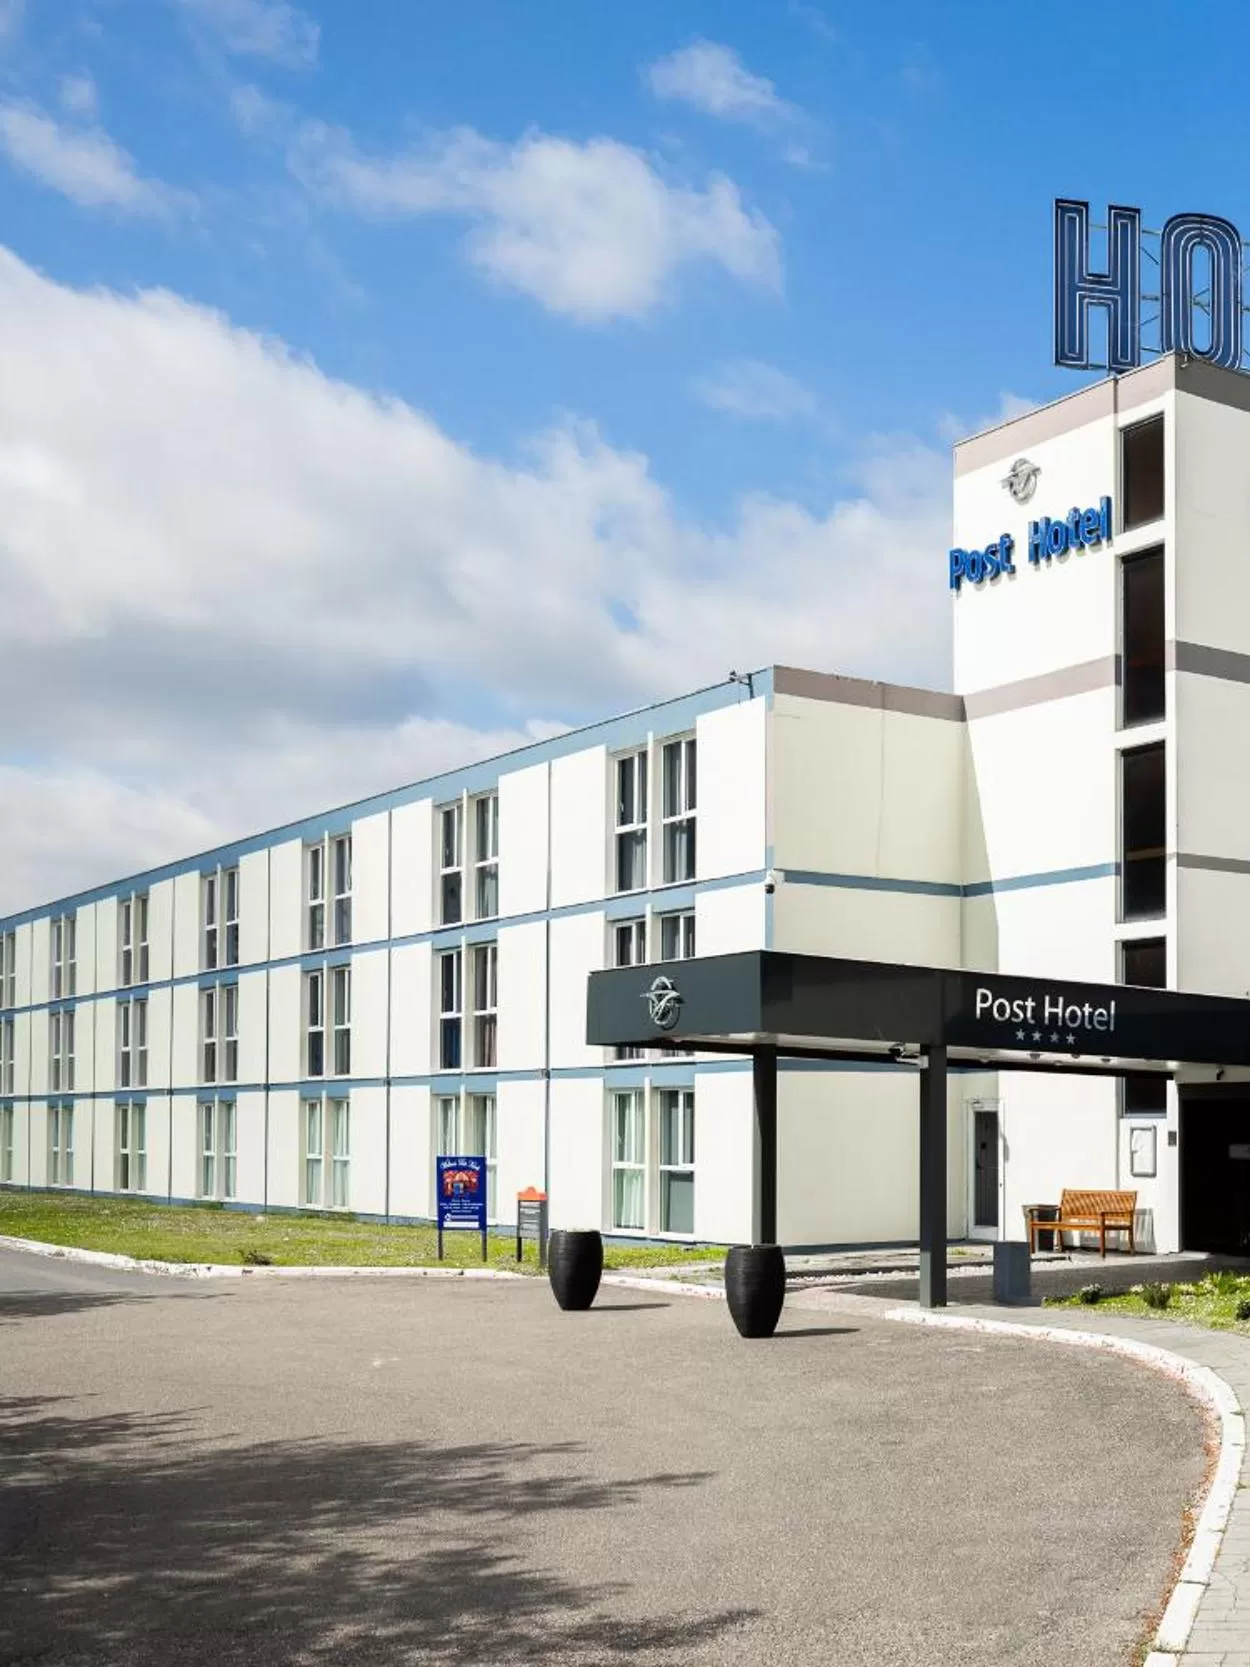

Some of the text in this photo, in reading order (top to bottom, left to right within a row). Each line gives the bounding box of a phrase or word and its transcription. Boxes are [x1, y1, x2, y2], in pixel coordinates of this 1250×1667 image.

[950, 497, 1112, 589] Post Hotel
[975, 988, 1115, 1032] Post Hotel
